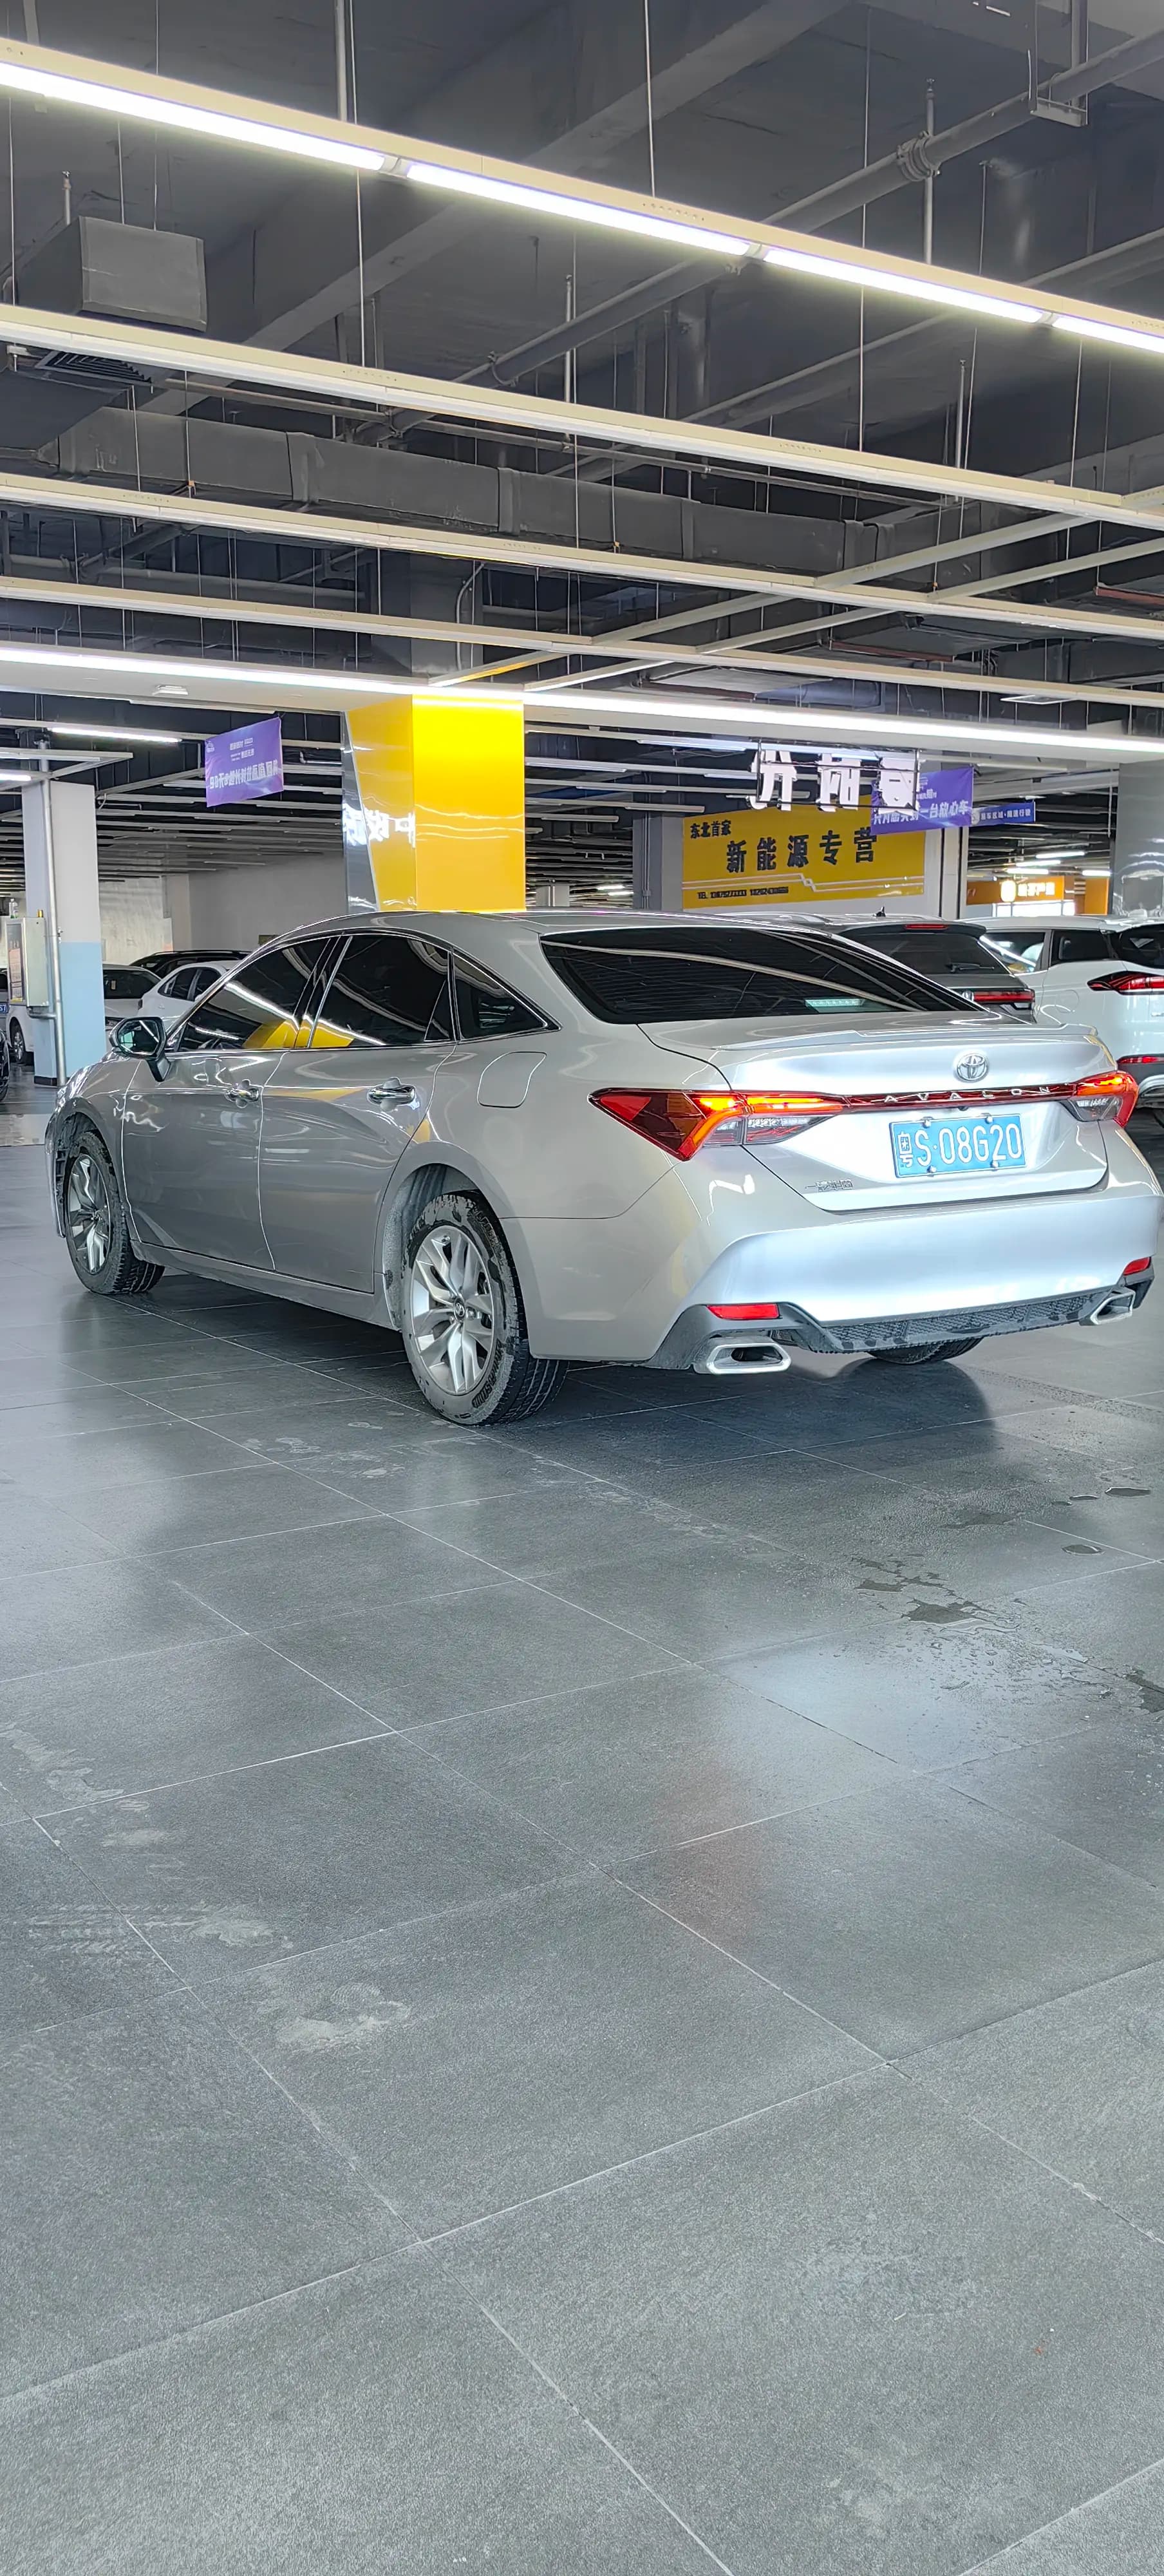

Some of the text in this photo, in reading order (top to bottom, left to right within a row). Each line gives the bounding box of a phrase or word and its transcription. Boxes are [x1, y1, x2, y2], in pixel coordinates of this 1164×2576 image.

[690, 820, 731, 838] 东北首家
[726, 827, 877, 873] 新能源专营
[884, 1086, 1049, 1103] AVALON
